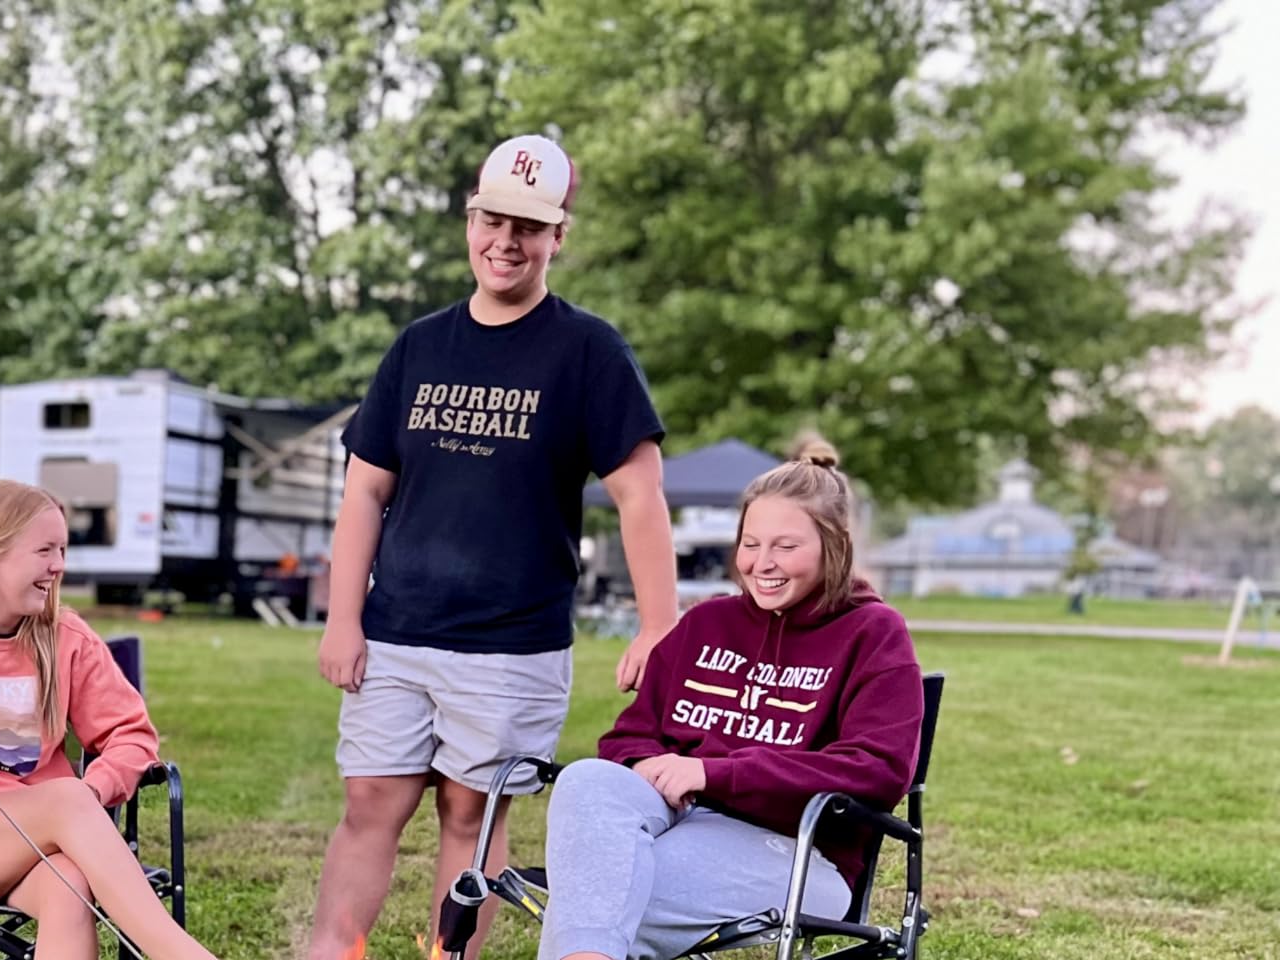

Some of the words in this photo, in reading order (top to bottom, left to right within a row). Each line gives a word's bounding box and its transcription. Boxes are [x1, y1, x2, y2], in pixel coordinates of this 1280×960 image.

[511, 151, 542, 187] BC
[414, 383, 540, 413] BOURBON
[407, 407, 530, 439] BASEBALL
[695, 645, 747, 674] LADY
[671, 699, 805, 746] SOFTBALL
